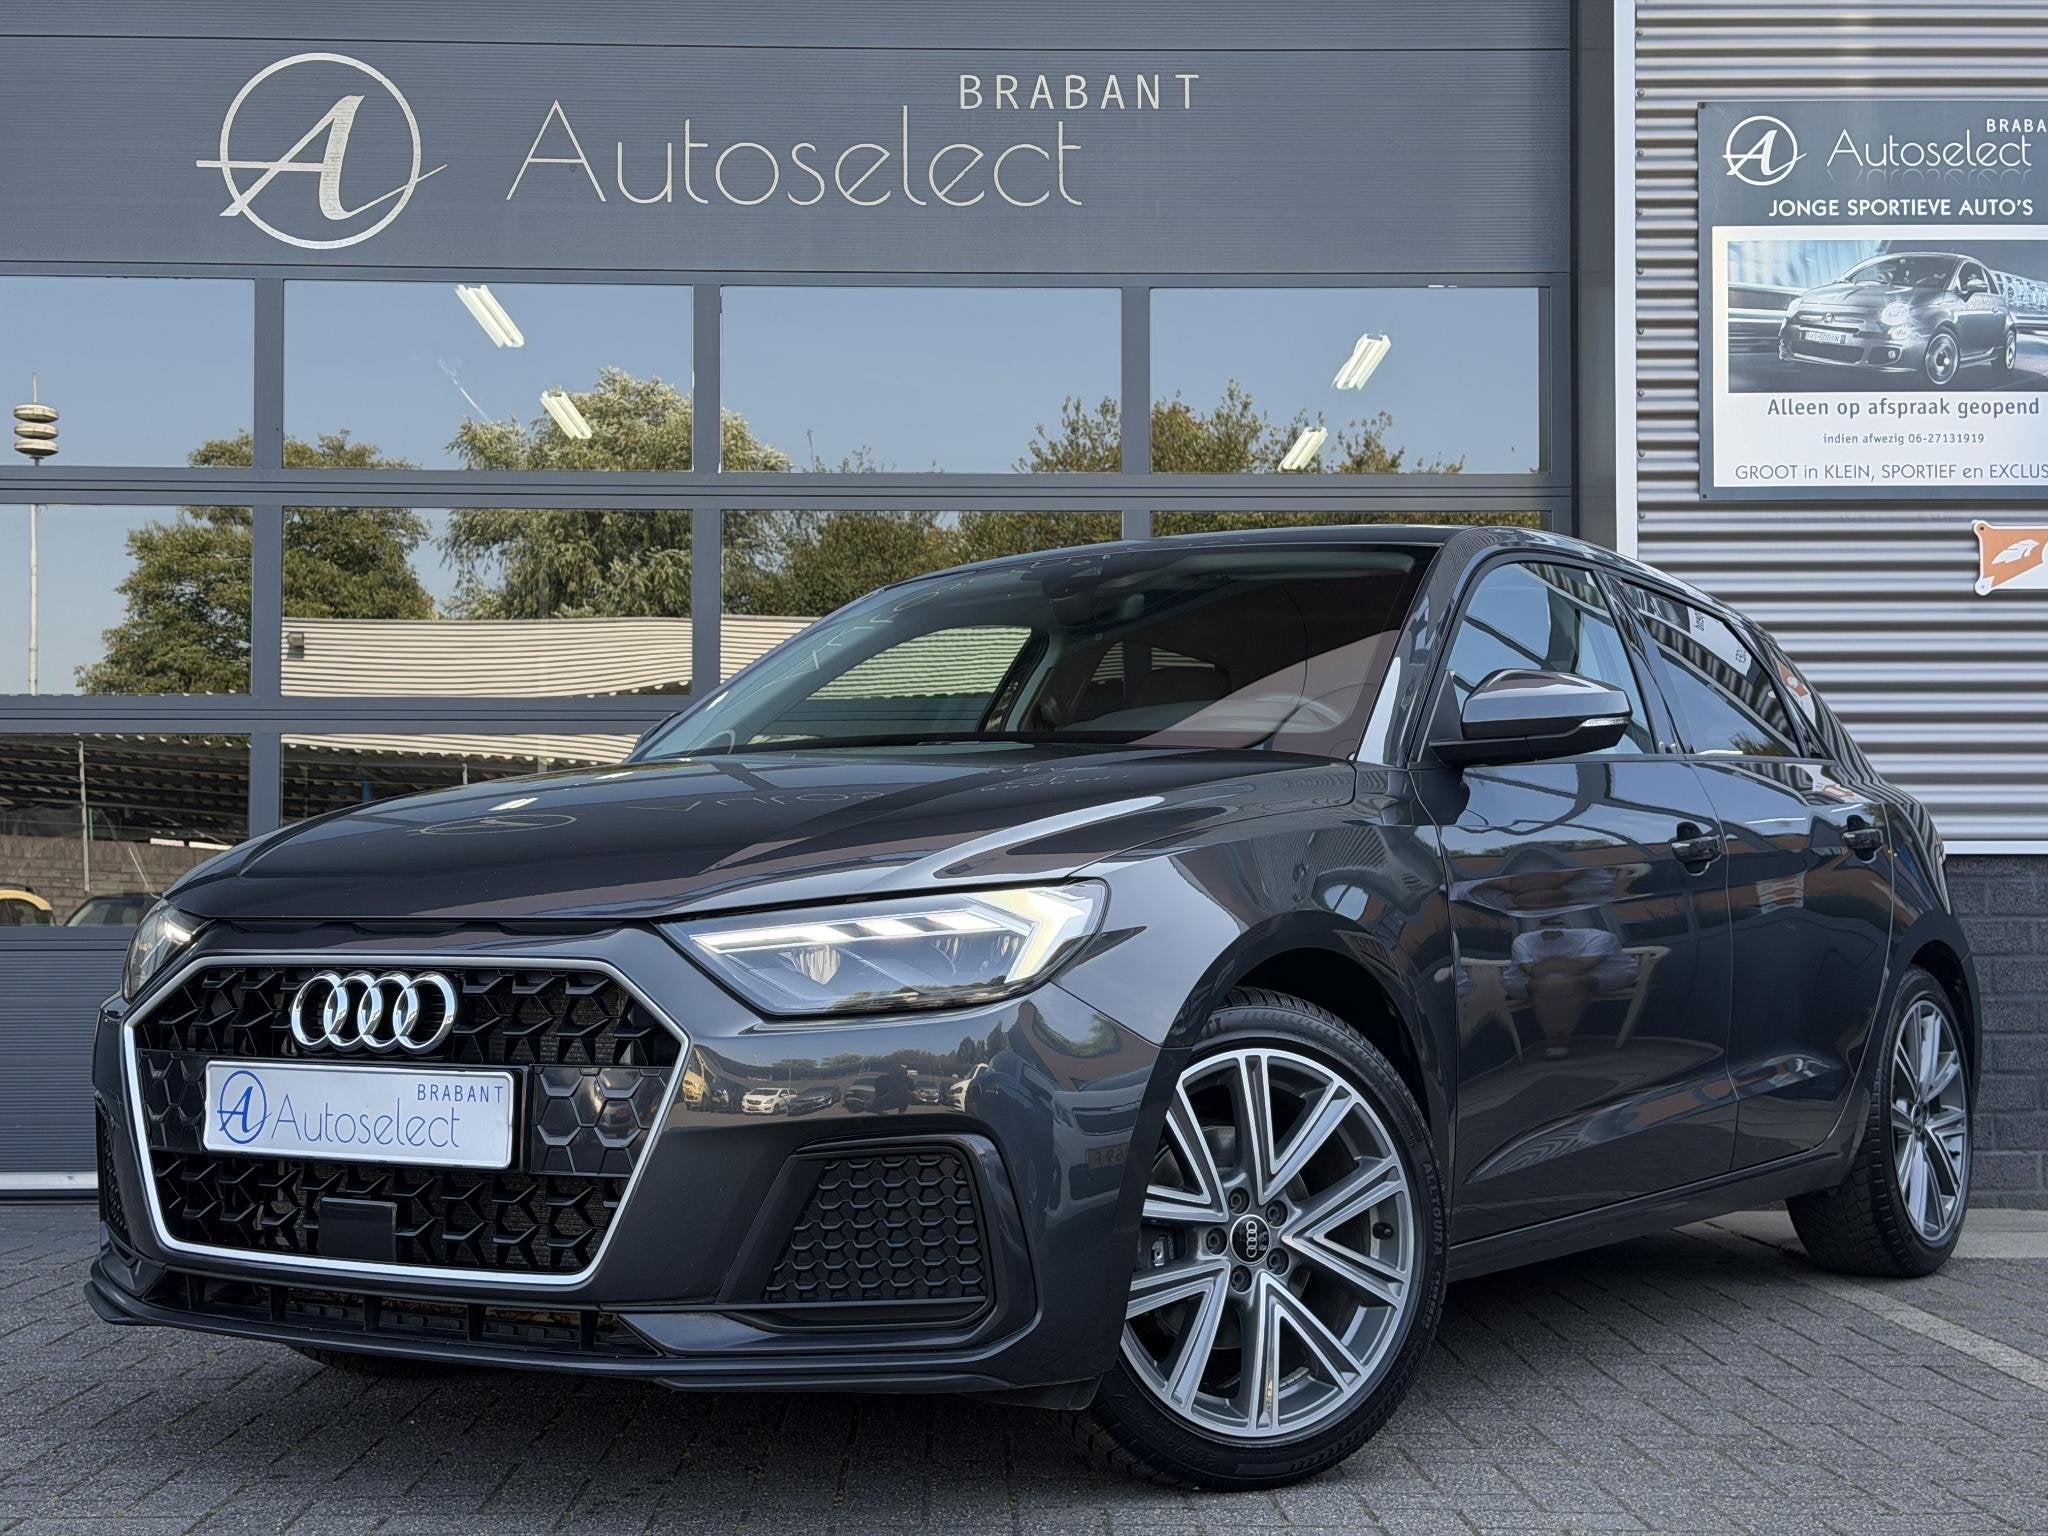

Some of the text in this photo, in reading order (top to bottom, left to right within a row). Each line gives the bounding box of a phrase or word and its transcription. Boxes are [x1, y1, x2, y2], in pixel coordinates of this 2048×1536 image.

[960, 74, 1200, 111] BRABANT
[1986, 118, 2047, 133] BRABA
[506, 100, 1083, 207] Autoselect
[1827, 128, 2033, 167] Autoselect
[1768, 198, 2034, 217] JONGE SPORTIEVE AUTO'S
[1767, 397, 2040, 419] Alleen op afspraak geopend
[1823, 432, 1985, 446] indien afwezig 06-27131919
[1735, 463, 2048, 482] GROOT in KLEIN, SPORTIEF en EXCLUS
[417, 1083, 503, 1104] BRABANT
[271, 1093, 461, 1148] Autoselect
